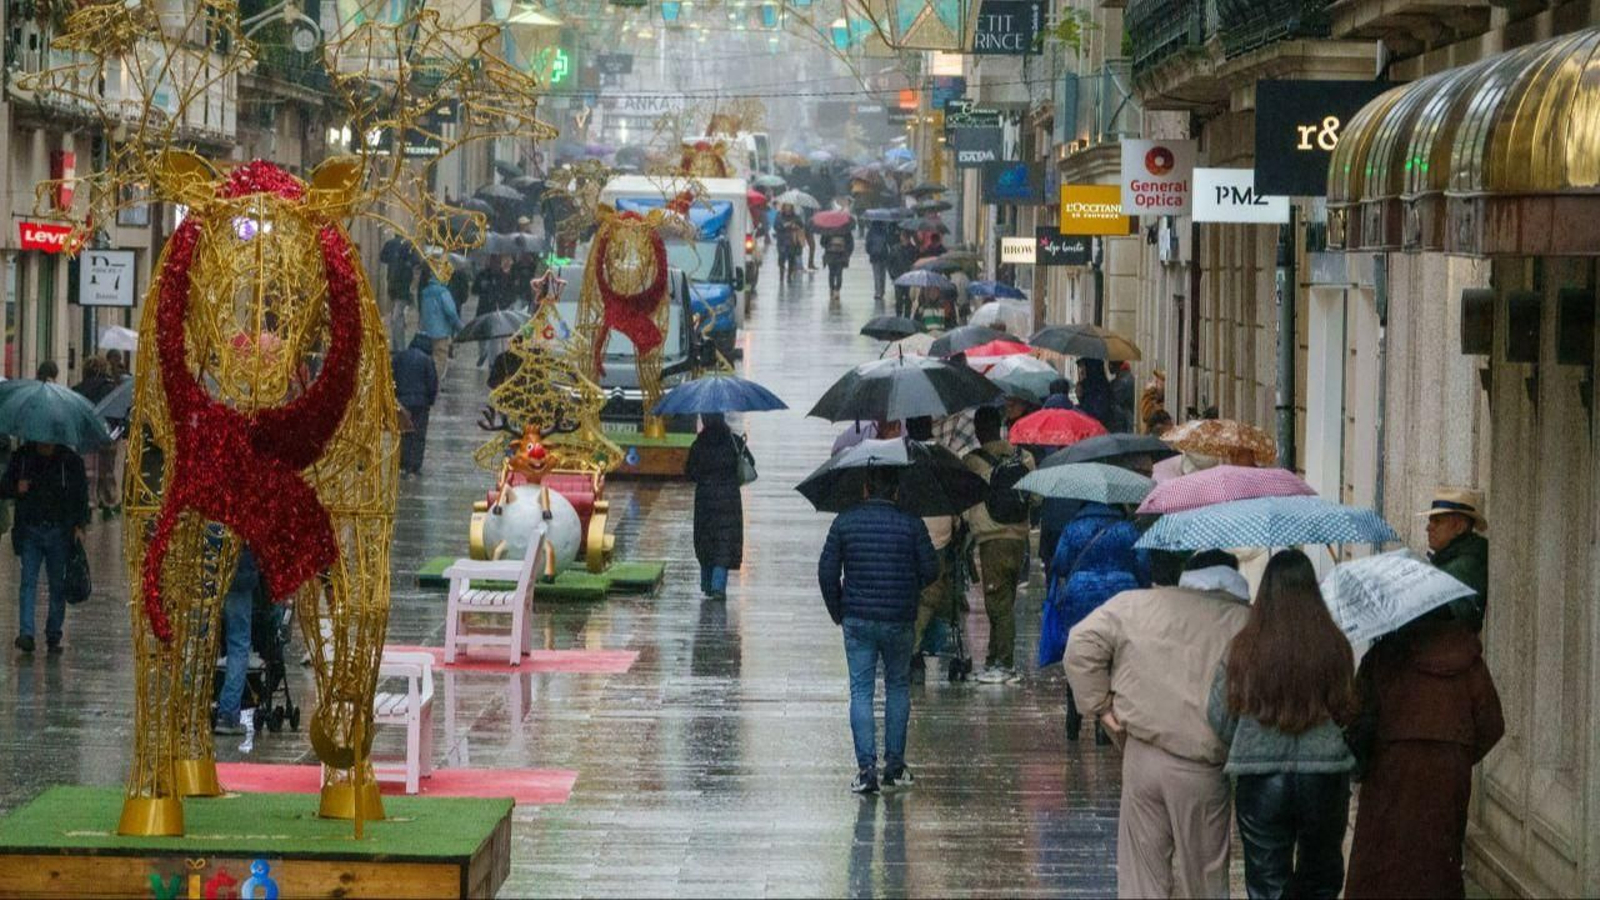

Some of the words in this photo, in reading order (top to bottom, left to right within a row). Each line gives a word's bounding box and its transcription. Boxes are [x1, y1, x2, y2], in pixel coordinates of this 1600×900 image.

[974, 14, 1014, 32] ETIT
[975, 33, 1025, 50] RINCE
[1130, 179, 1188, 192] General
[1066, 202, 1121, 213] L'OCCITAN
[1135, 194, 1183, 208] Optica
